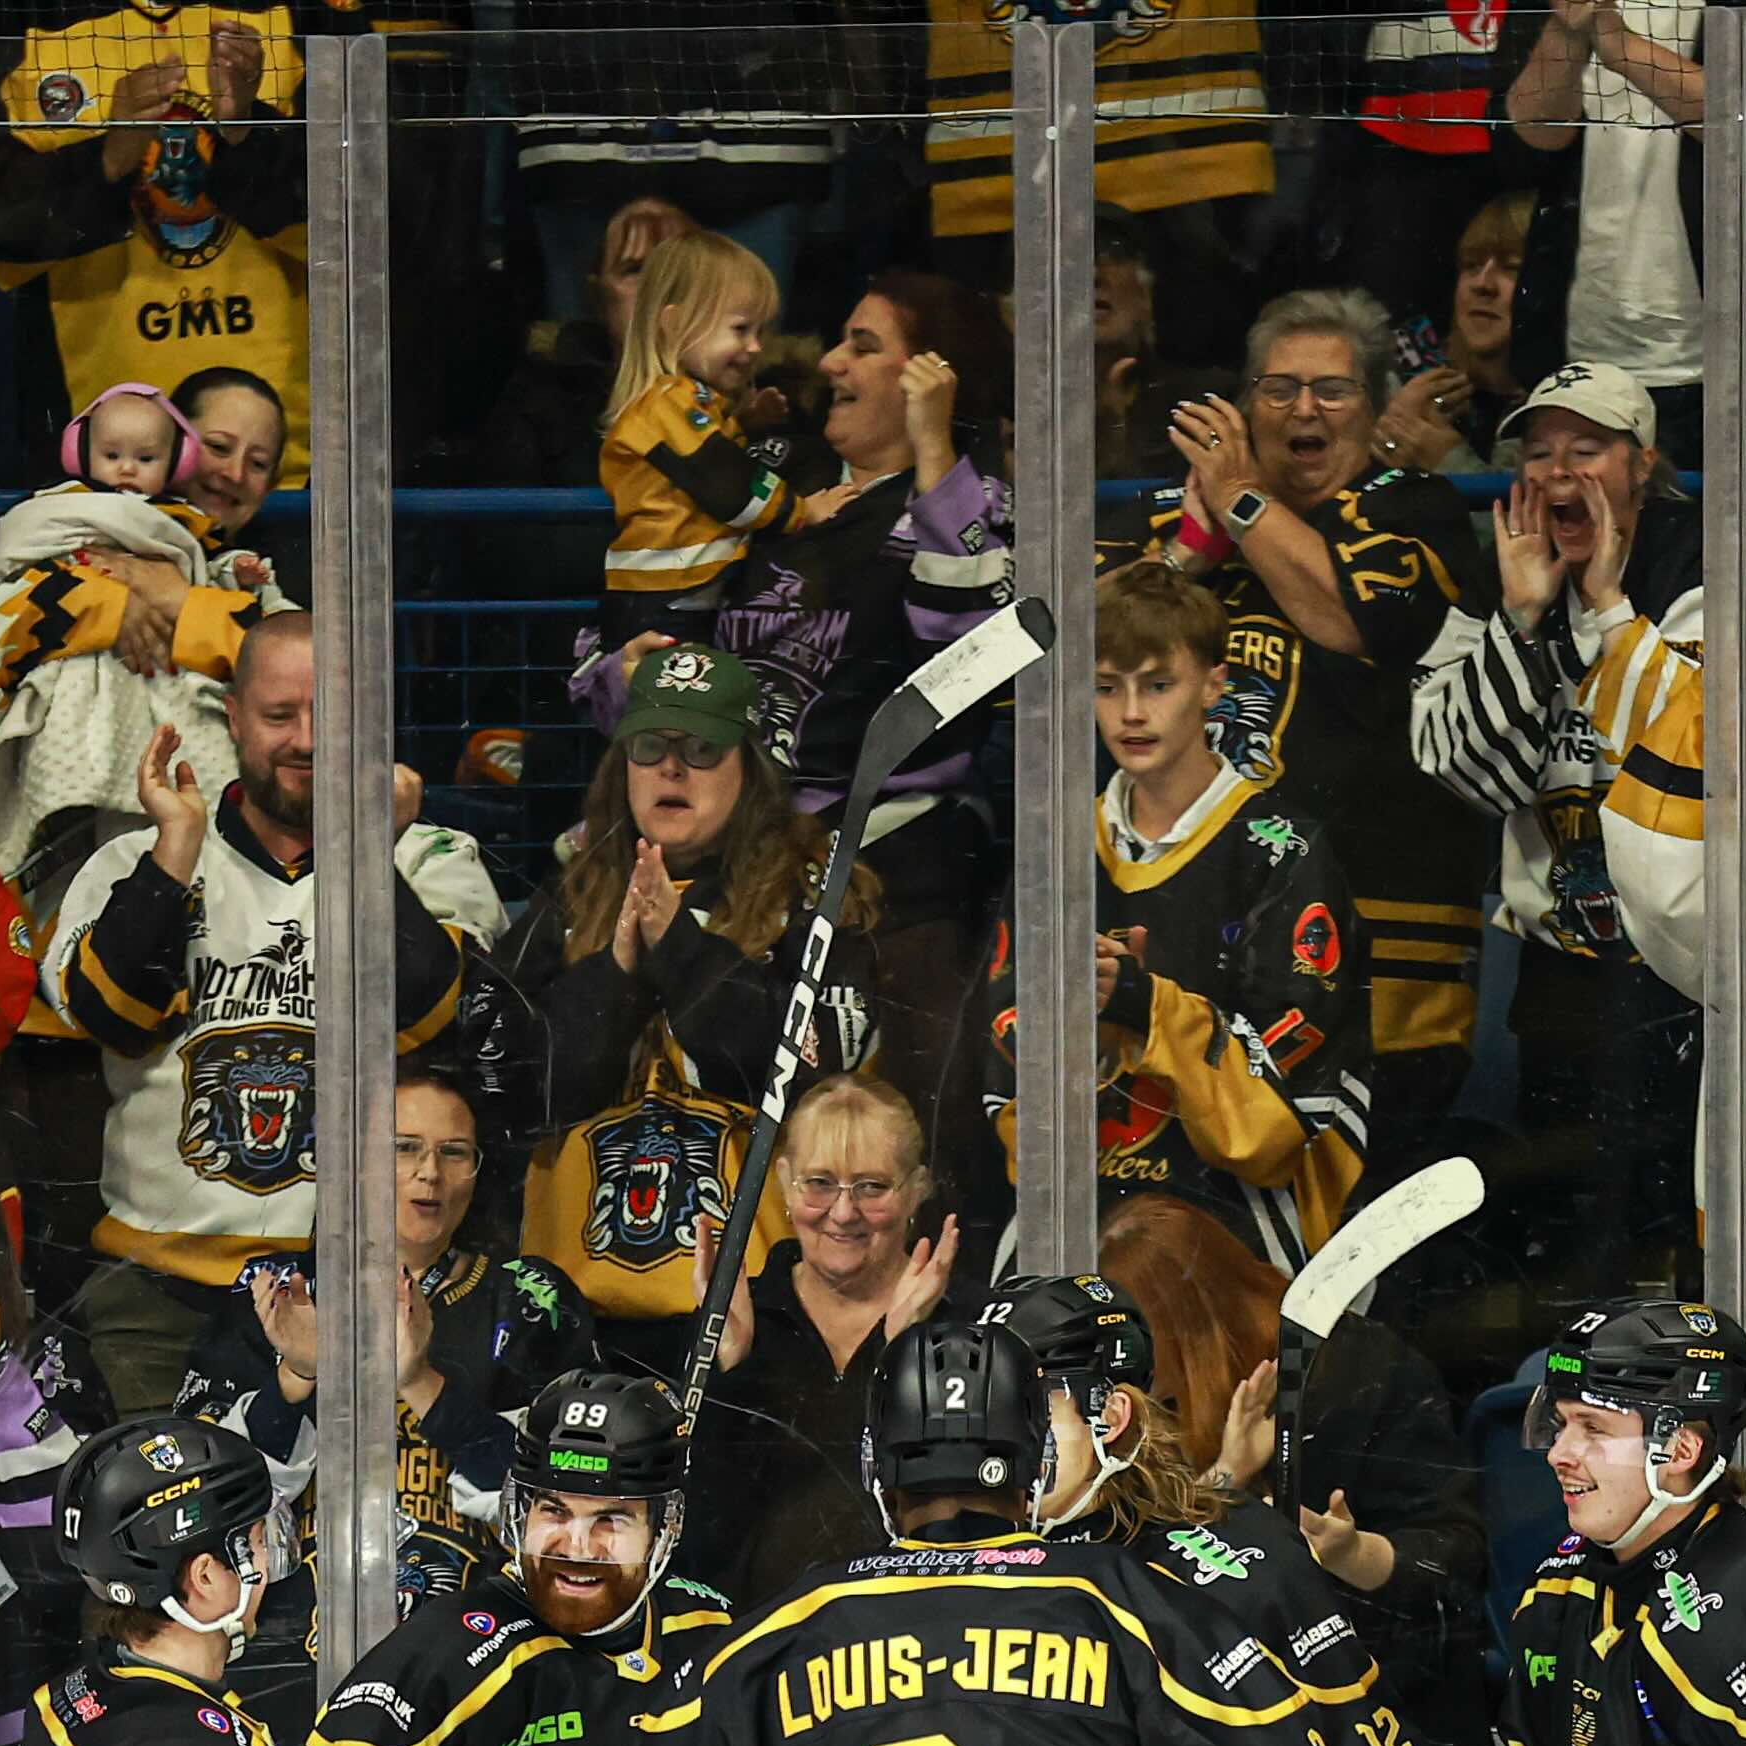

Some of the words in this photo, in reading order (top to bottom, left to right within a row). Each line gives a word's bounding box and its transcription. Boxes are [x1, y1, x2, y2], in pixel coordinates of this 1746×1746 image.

[137, 295, 254, 342] GMB
[762, 914, 835, 1123] CCM
[977, 1302, 1013, 1326] 12
[1097, 1313, 1127, 1326] CCM
[1570, 1311, 1606, 1334] 73
[1685, 1347, 1726, 1361] CCM
[945, 1378, 966, 1409] 2
[564, 1402, 607, 1428] 89
[549, 1450, 609, 1472] WAGO
[146, 1476, 201, 1509] CCM
[64, 1506, 81, 1540] 17
[848, 1548, 1046, 1575] weatherTech
[466, 1618, 536, 1668] MOTORPOINT
[776, 1626, 1110, 1739] LOUIS-JEAN
[339, 1681, 395, 1704] ABETES
[394, 1694, 416, 1724] UK
